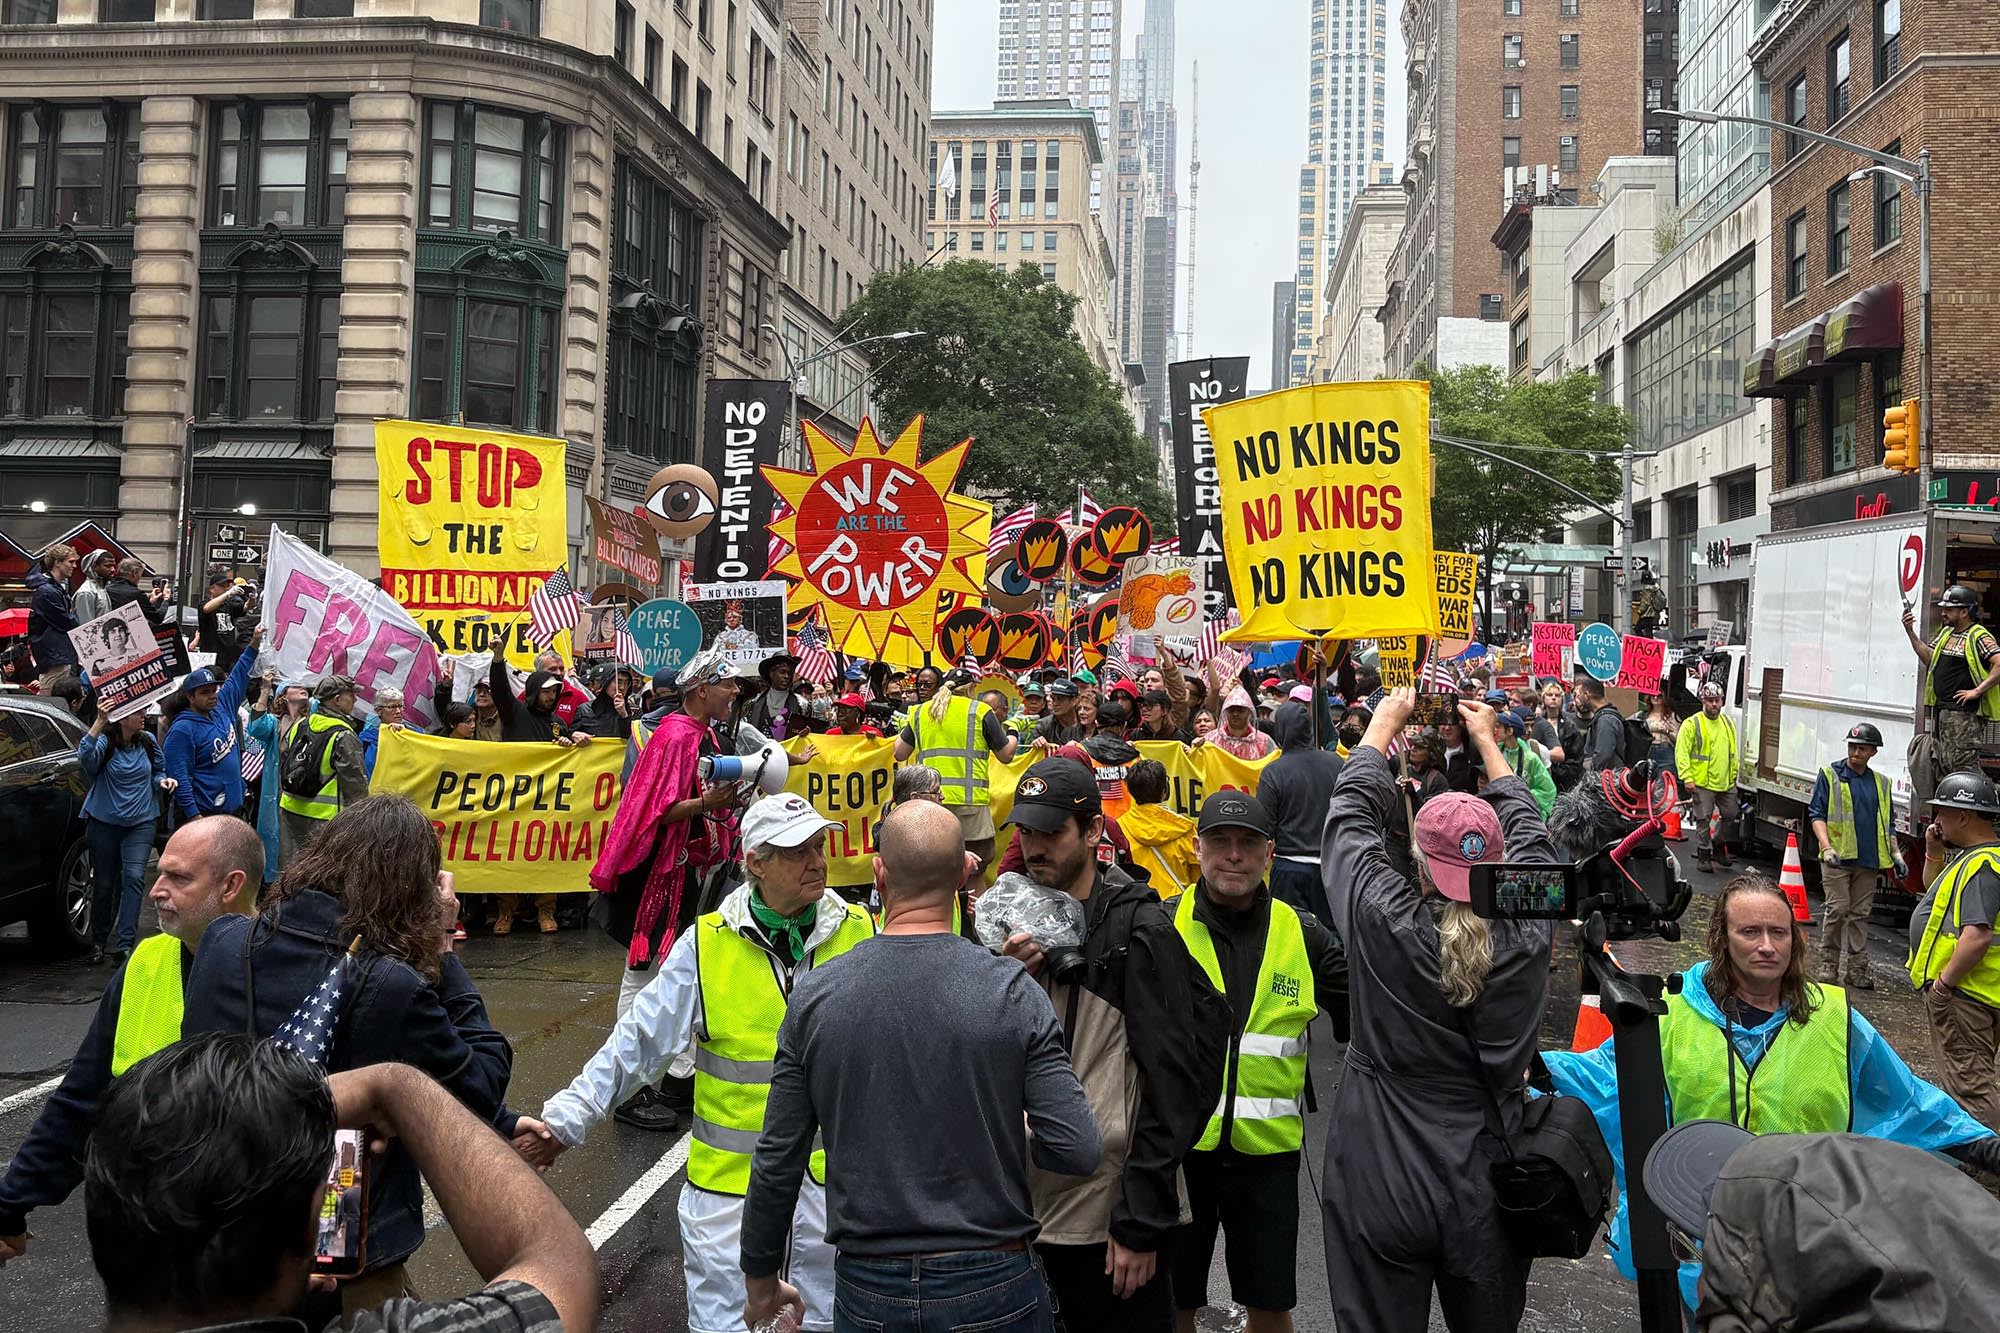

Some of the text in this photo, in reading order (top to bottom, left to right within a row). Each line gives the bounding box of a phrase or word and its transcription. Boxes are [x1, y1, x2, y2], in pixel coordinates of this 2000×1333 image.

[1189, 380, 1222, 400] NO
[725, 401, 766, 426] NO
[1233, 419, 1401, 482] NO KINGS
[406, 437, 542, 508] STOP
[821, 463, 915, 514] WE
[716, 428, 757, 584] DETENTIO
[1242, 484, 1403, 546] NO KINGS
[598, 503, 644, 538] PEOPLE
[836, 515, 907, 531] ARE THE
[443, 523, 504, 555] THE
[216, 550, 255, 559] ONE WAY
[596, 536, 658, 584] BILLIONAIRES
[1452, 556, 1473, 567] FOR
[806, 533, 943, 606] POWER
[1126, 557, 1149, 576] NO
[1299, 550, 1405, 600] KINGS
[708, 589, 721, 598] NO
[726, 587, 758, 597] KINGS
[1438, 596, 1469, 614] WAR
[637, 609, 681, 630] PEACE
[653, 632, 670, 647] IS
[1533, 625, 1574, 642] RESTORE
[1586, 633, 1616, 647] PEACE
[588, 650, 605, 659] FREE
[644, 649, 682, 665] OWER
[743, 650, 767, 659] 1776
[1597, 647, 1606, 658] IS
[1624, 638, 1662, 658] MAGA
[1388, 656, 1409, 671] WAR
[1586, 657, 1616, 672] POWER
[1632, 656, 1648, 671] IS
[101, 677, 128, 697] FREE
[127, 660, 164, 685] DYLAN
[128, 679, 151, 697] THEM
[151, 671, 168, 687] ALL
[1619, 671, 1661, 692] FASCISM
[1096, 766, 1119, 775] TRUMP
[431, 771, 575, 812] PEOPLE
[1273, 971, 1286, 984] RISE
[1272, 981, 1300, 999] RESIST
